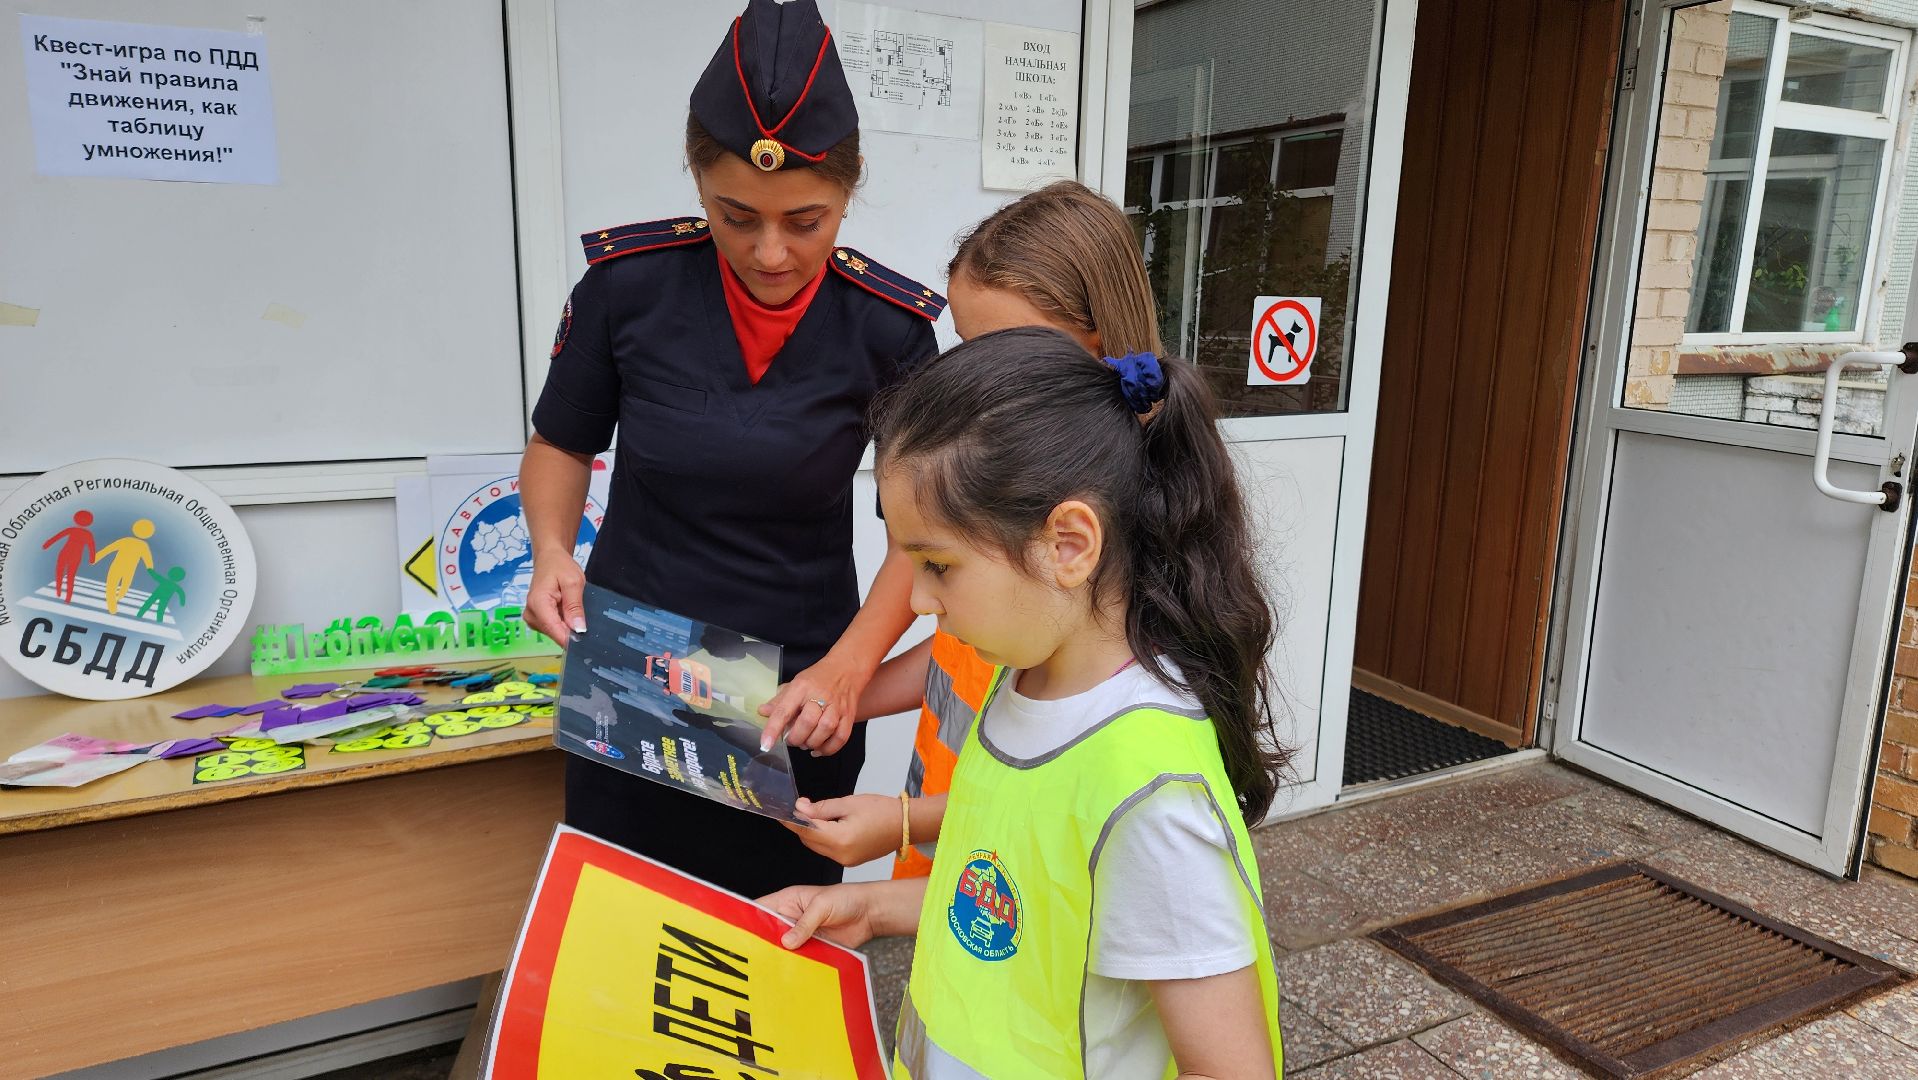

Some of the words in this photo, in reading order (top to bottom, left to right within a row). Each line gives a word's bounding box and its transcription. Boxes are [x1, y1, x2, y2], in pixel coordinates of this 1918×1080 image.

[33, 34, 166, 63] Квест-игра
[174, 49, 201, 64] по
[209, 48, 259, 71] ПДД
[1005, 56, 1066, 71] НАЧАЛЬНАЯ
[1023, 42, 1050, 54] ВХОД
[61, 62, 132, 83] "Знай
[140, 71, 239, 91] правила
[1016, 72, 1056, 84] ШКОЛА:
[68, 92, 195, 115] движения,
[202, 100, 238, 116] как
[108, 117, 204, 140] таблицу
[82, 143, 233, 163] умножения!"
[74, 476, 184, 504] Региональная
[2, 486, 72, 539] Областная
[185, 499, 237, 584] Общественная
[177, 590, 238, 665] Организация
[19, 617, 165, 688] СБДД
[959, 868, 1014, 929] БДД
[949, 908, 982, 954] МОСКОВСКАЯ
[983, 945, 1014, 957] ОБЛАСТЬ
[653, 923, 779, 1075] ДЕТИ
